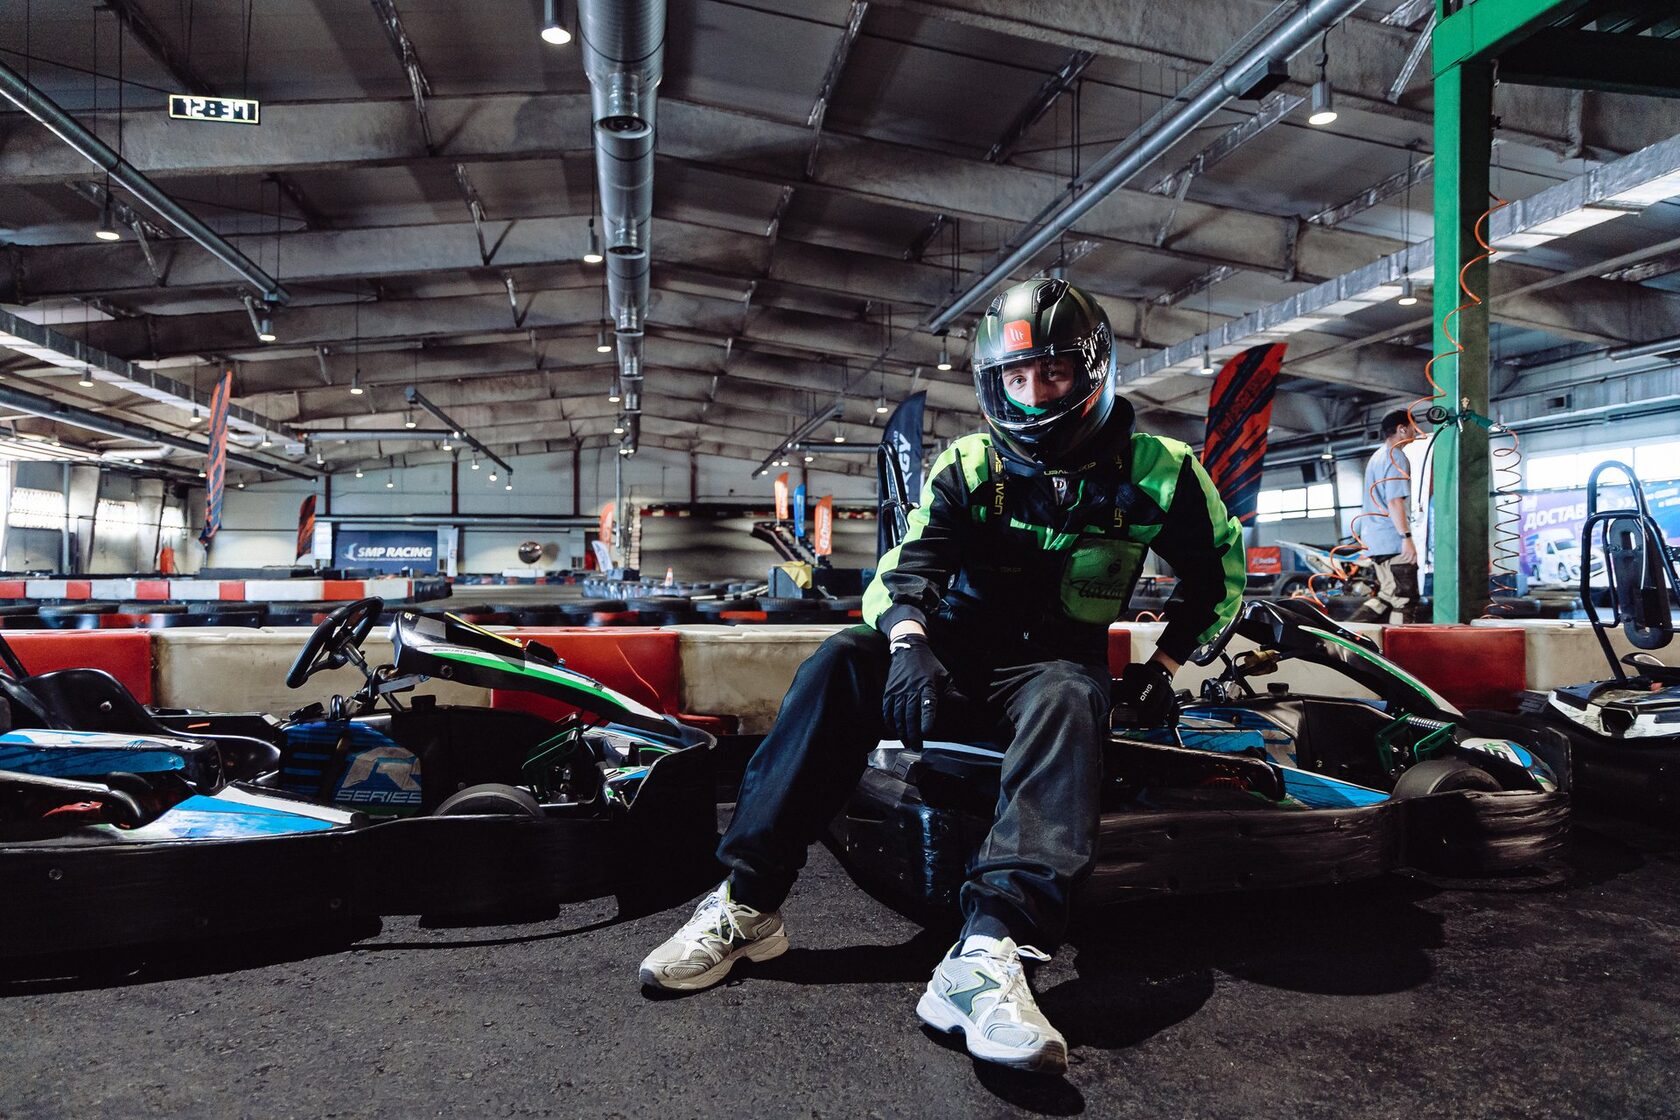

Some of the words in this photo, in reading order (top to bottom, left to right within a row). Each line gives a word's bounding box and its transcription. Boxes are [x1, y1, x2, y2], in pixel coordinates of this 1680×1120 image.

[993, 481, 1005, 515] URAL
[357, 547, 386, 558] SMP
[386, 546, 433, 558] RACING
[335, 789, 422, 804] SERIES
